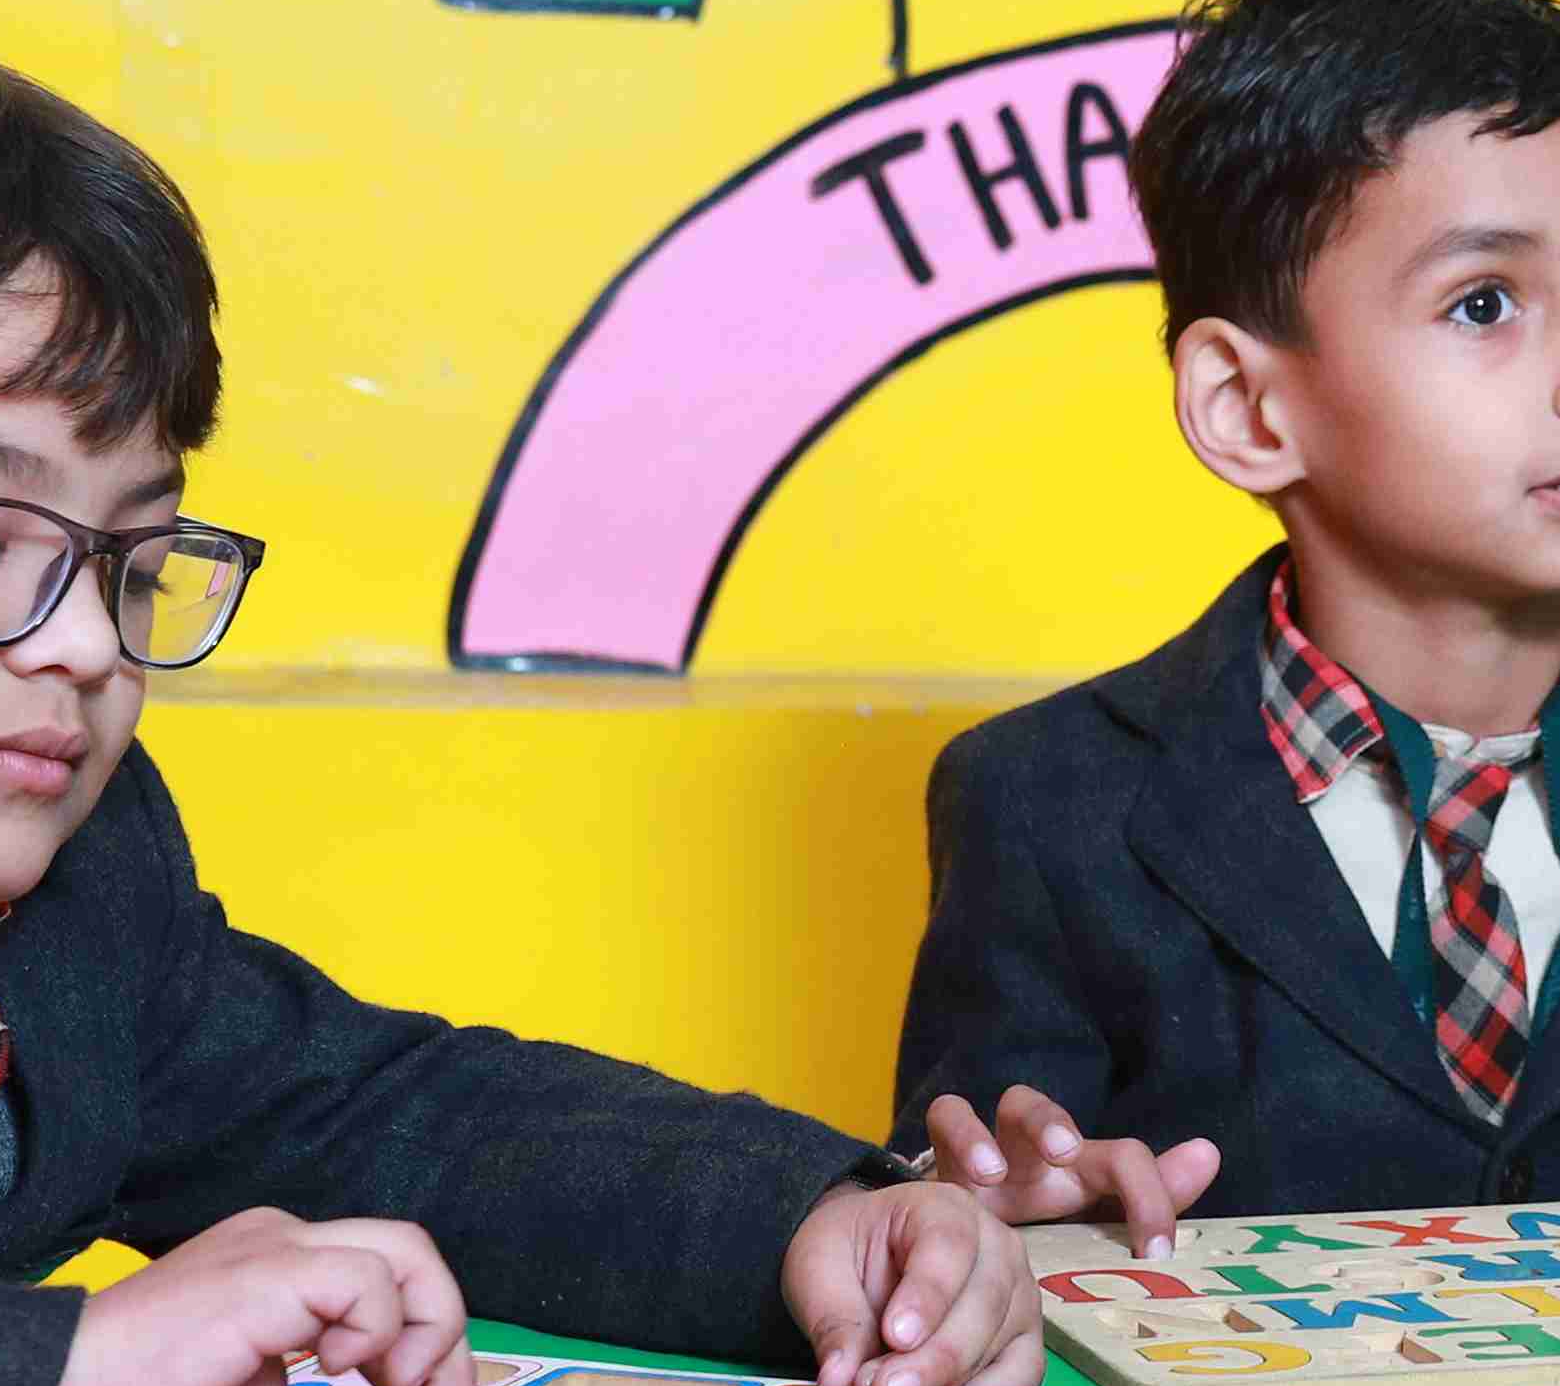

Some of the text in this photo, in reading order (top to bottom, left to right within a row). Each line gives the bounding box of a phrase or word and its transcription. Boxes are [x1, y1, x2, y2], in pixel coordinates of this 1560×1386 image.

[808, 79, 1134, 288] THA
[1239, 1224, 1385, 1254] Y
[1337, 1216, 1512, 1247] X
[1038, 1269, 1209, 1303] U
[1201, 1265, 1333, 1296] T
[1251, 1292, 1471, 1330] M
[1136, 1340, 1312, 1375] G
